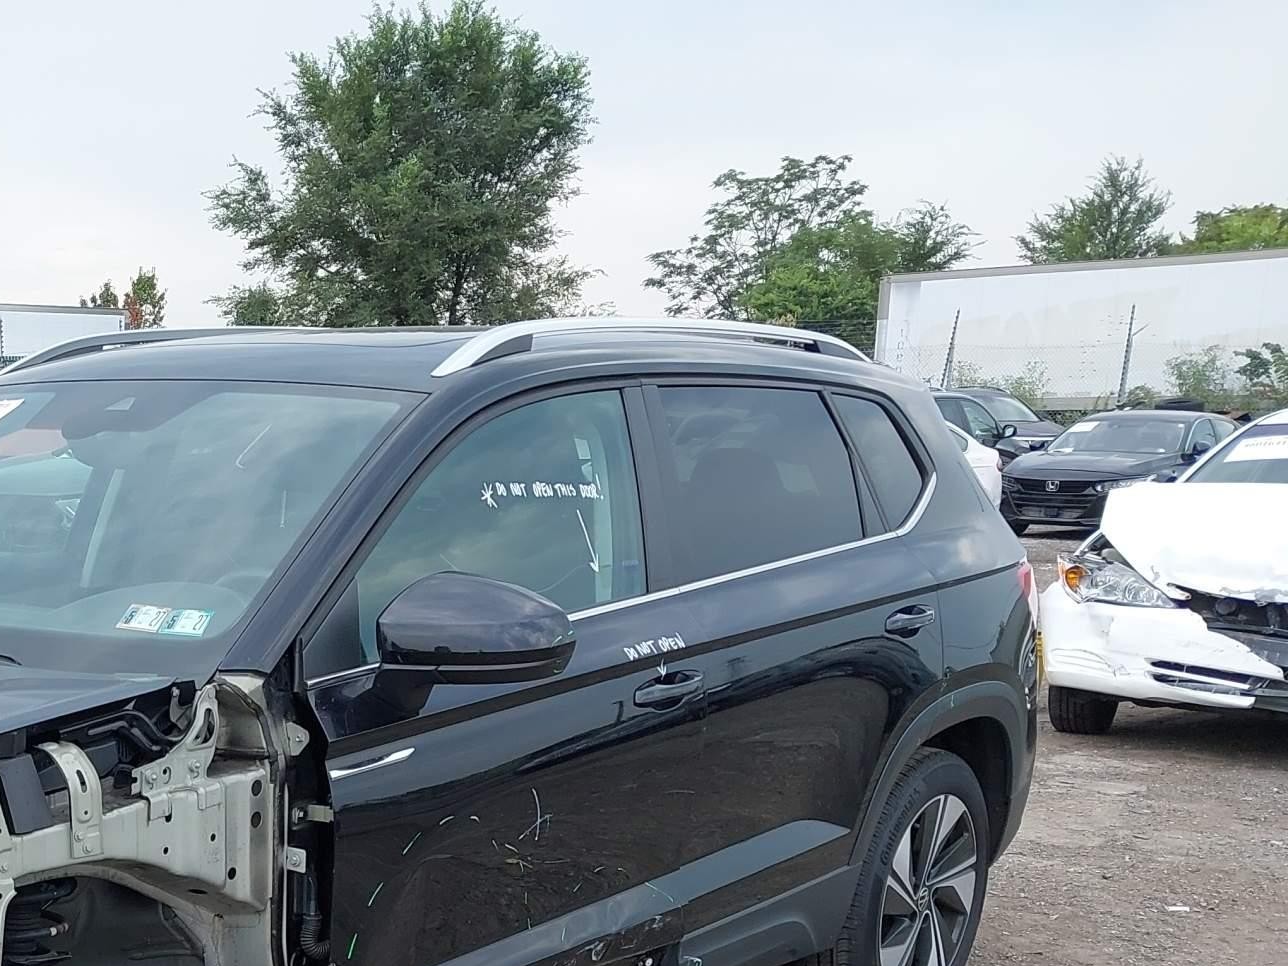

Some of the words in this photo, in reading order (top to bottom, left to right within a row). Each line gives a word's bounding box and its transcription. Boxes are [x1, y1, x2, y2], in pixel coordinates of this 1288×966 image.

[495, 481, 508, 497] DO
[510, 482, 527, 498] NOT
[532, 481, 554, 498] OPEN
[554, 482, 577, 498] THIS
[623, 647, 639, 661] DO
[634, 640, 658, 656] NOT
[658, 632, 686, 652] OPEN
